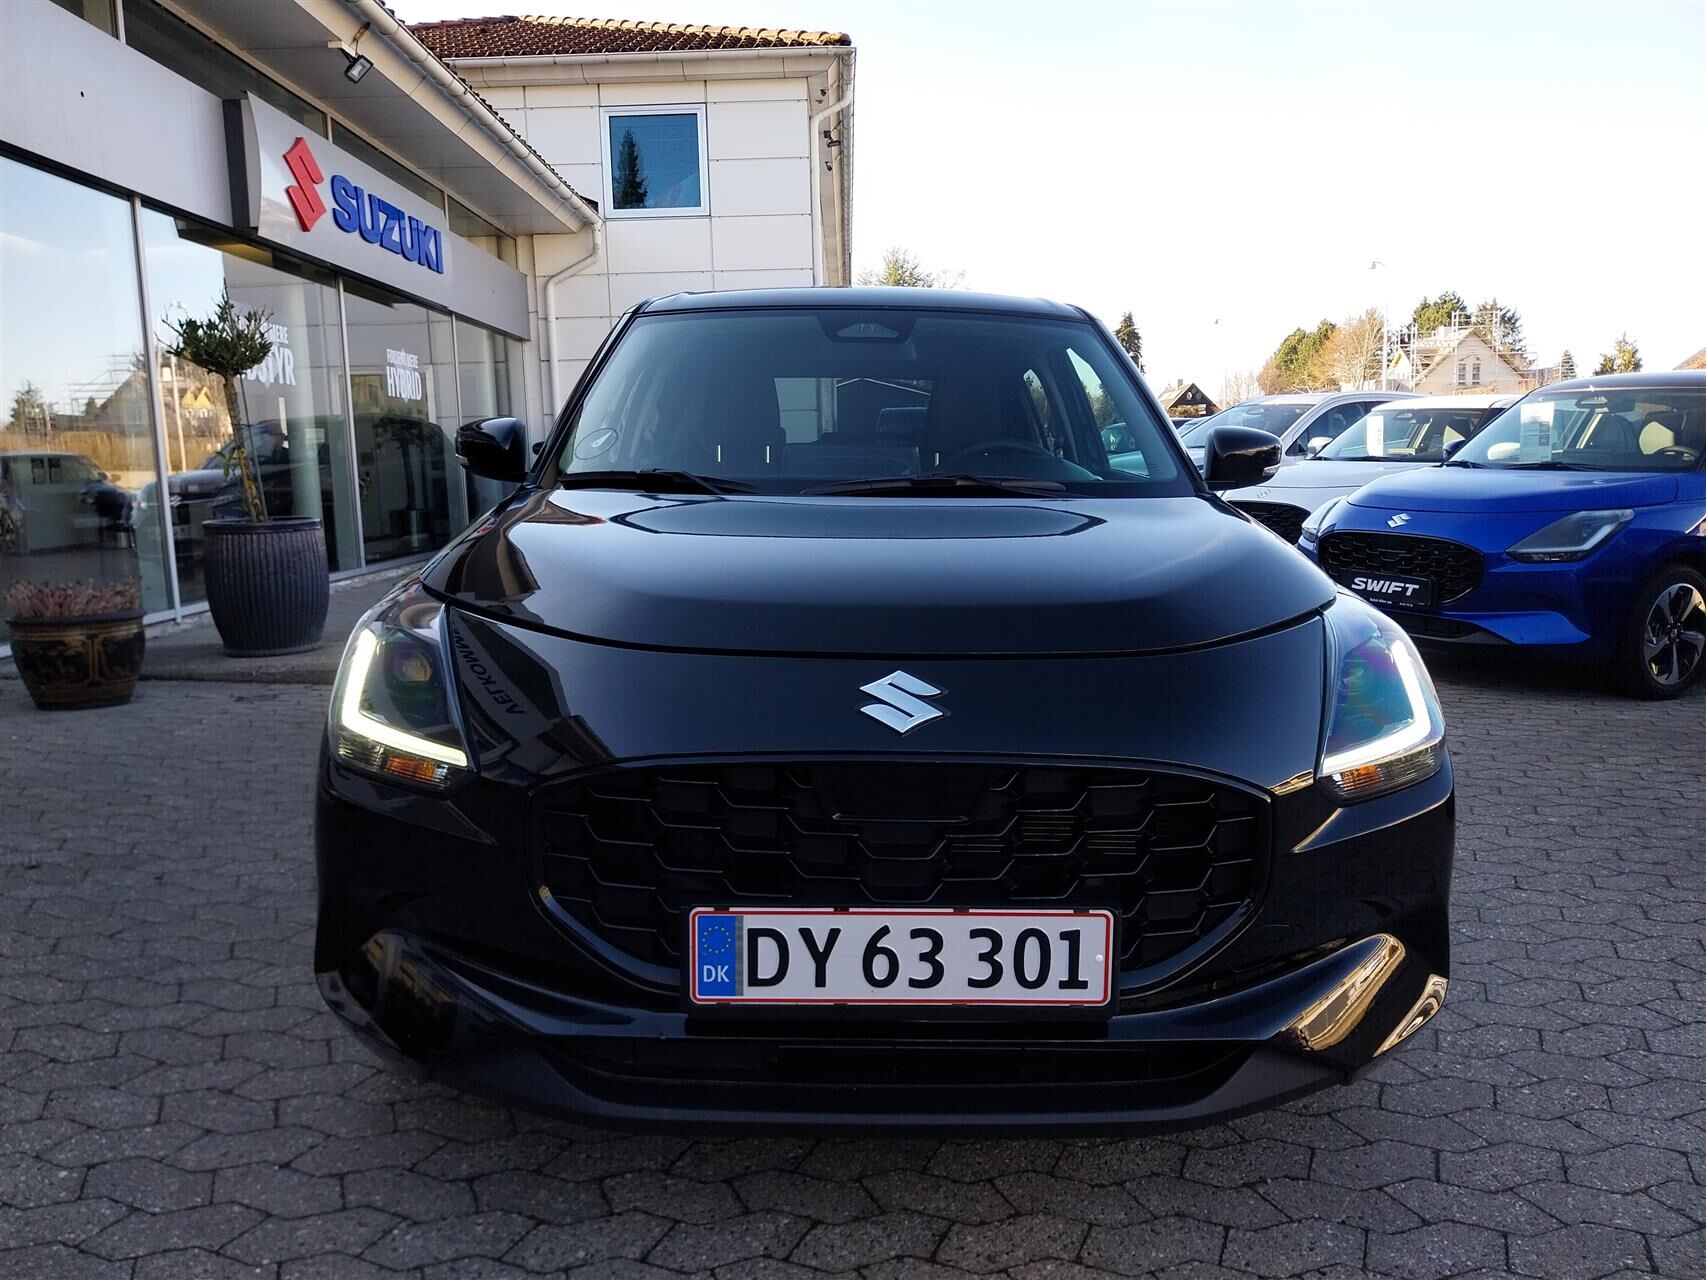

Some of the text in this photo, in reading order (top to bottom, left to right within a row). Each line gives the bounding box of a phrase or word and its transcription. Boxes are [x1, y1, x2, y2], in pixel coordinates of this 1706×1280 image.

[331, 174, 444, 275] SUZUKI
[386, 365, 422, 401] HYBRID
[1351, 577, 1420, 596] SWIFT
[702, 965, 730, 983] DK
[747, 924, 1089, 990] DY 63 301
